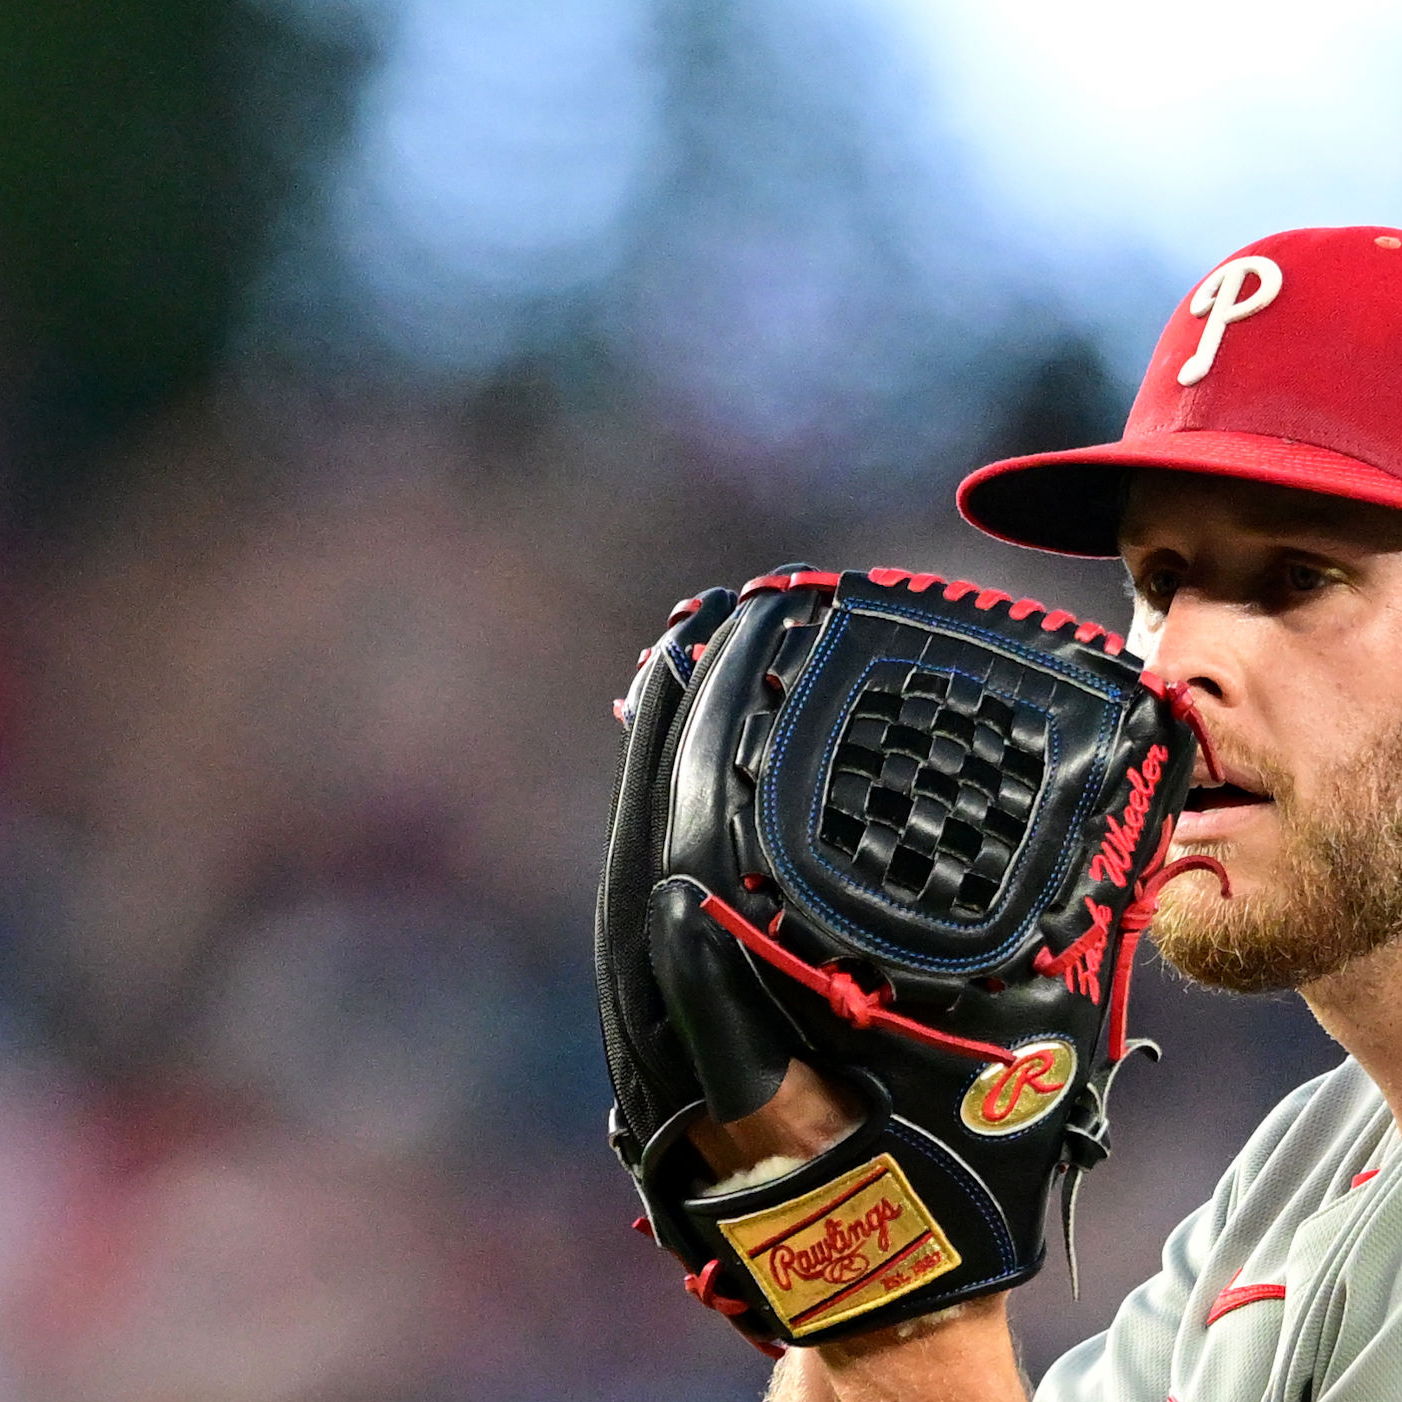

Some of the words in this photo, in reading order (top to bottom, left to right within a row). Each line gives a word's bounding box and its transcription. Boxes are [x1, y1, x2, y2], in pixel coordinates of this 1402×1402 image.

[1177, 256, 1283, 386] P
[1089, 744, 1169, 888] Wheeler
[982, 1049, 1065, 1122] R
[769, 1197, 903, 1291] Rawlings
